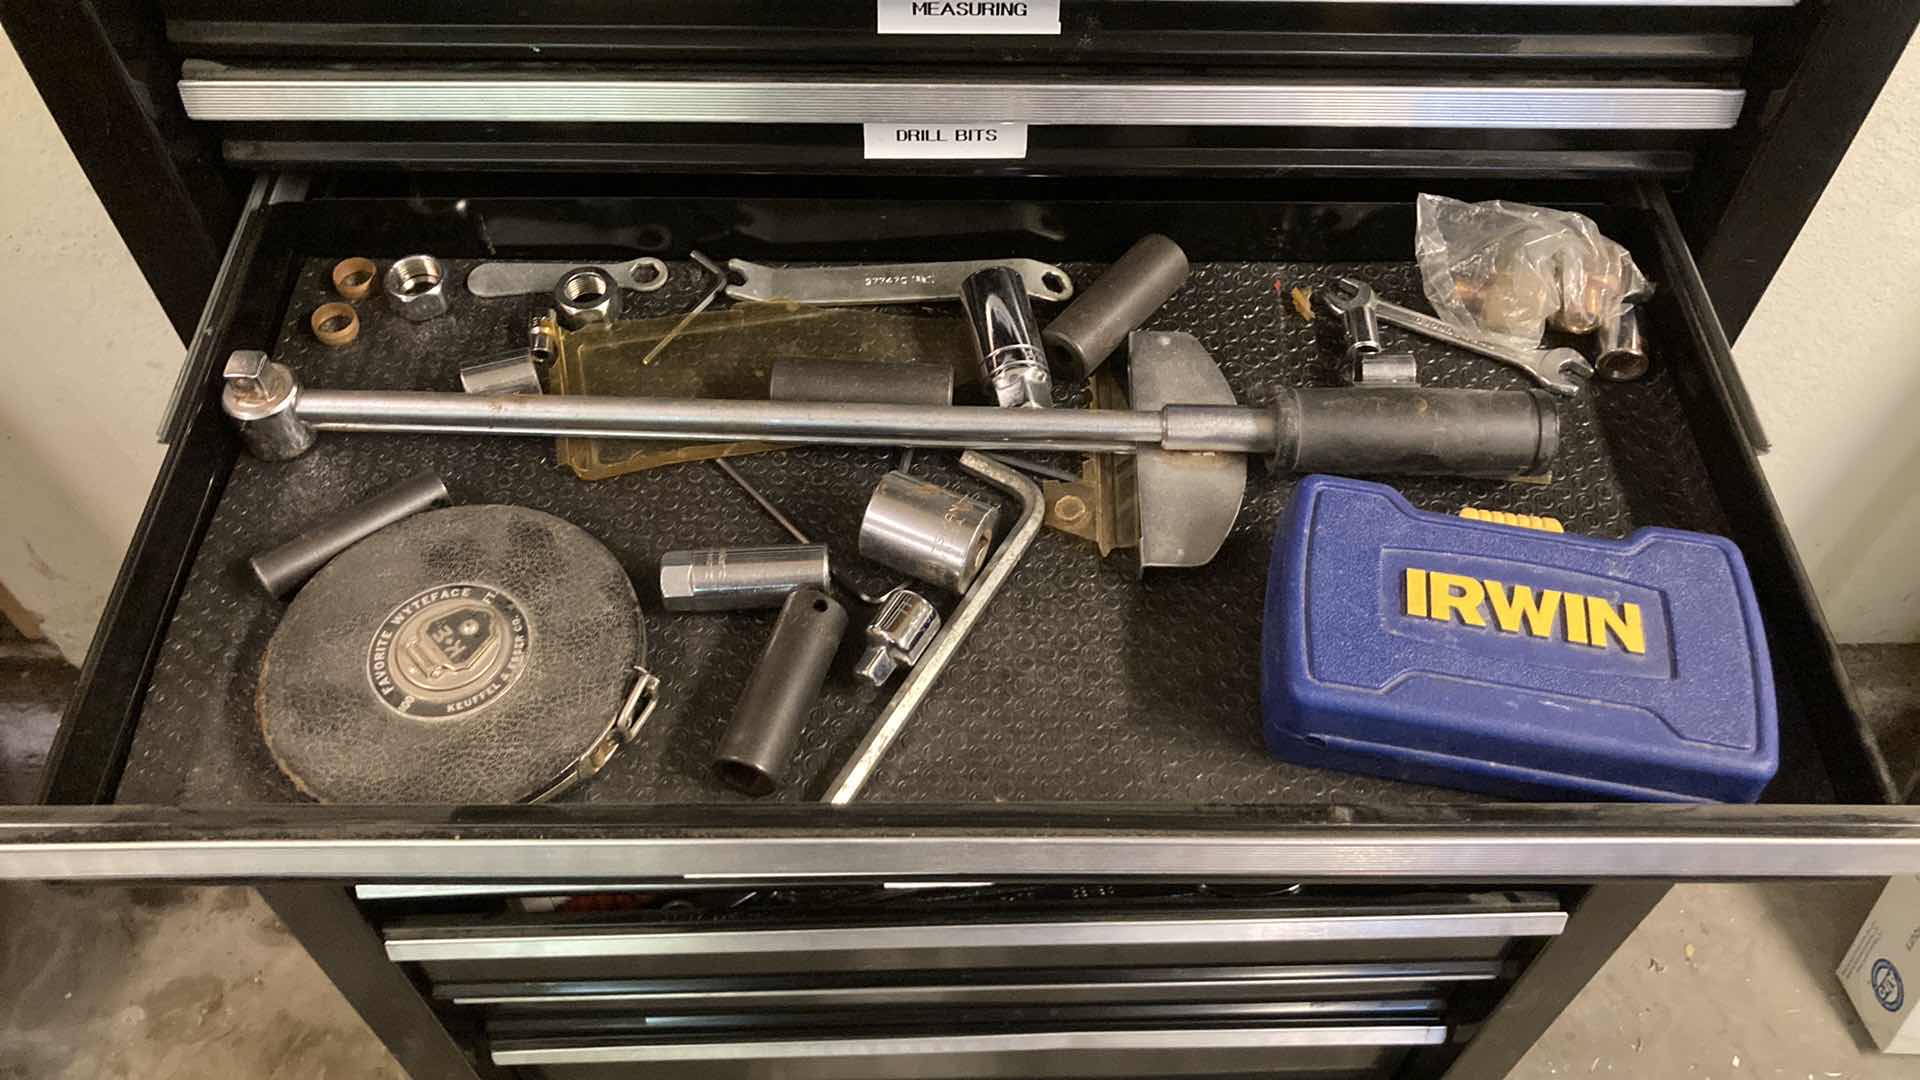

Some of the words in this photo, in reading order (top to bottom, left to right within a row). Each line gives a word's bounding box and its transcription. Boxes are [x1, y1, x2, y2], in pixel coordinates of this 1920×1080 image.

[912, 1, 1028, 17] MEASURING
[896, 128, 947, 142] DRILL
[955, 128, 998, 142] BITS
[1403, 567, 1647, 655] IRWIN
[371, 630, 395, 696] FAVORITE
[390, 587, 473, 626] WYTEFACE
[446, 682, 503, 713] KEUFFEL
